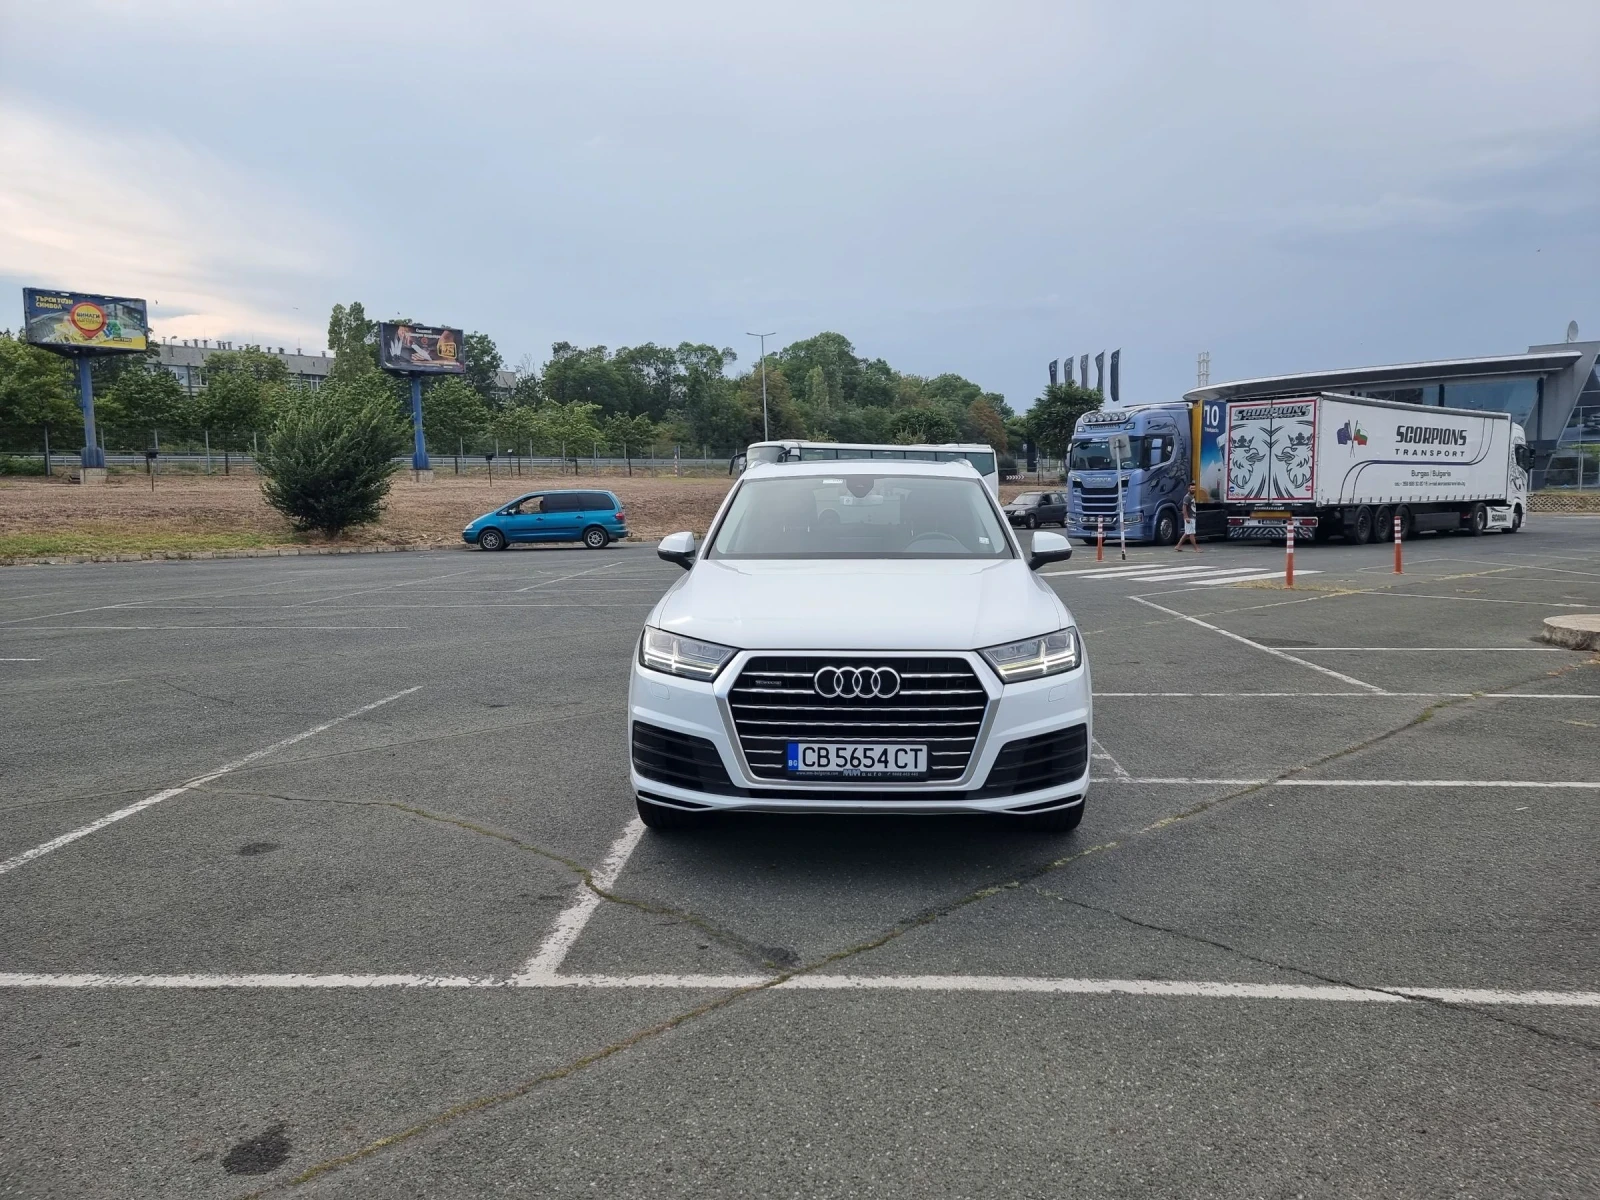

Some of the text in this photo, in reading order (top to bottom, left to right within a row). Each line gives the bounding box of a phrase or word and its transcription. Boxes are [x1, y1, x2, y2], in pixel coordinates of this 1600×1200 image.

[35, 302, 62, 310] СИМВОЛ
[1233, 404, 1312, 420] SCORPIONS
[1395, 425, 1468, 446] SCORPIONS
[1395, 448, 1465, 457] TRANSPORT
[1411, 469, 1430, 479] Burgas
[1432, 469, 1452, 479] Bulgaria
[802, 746, 923, 769] CB 5654 CT
[788, 759, 798, 767] BG
